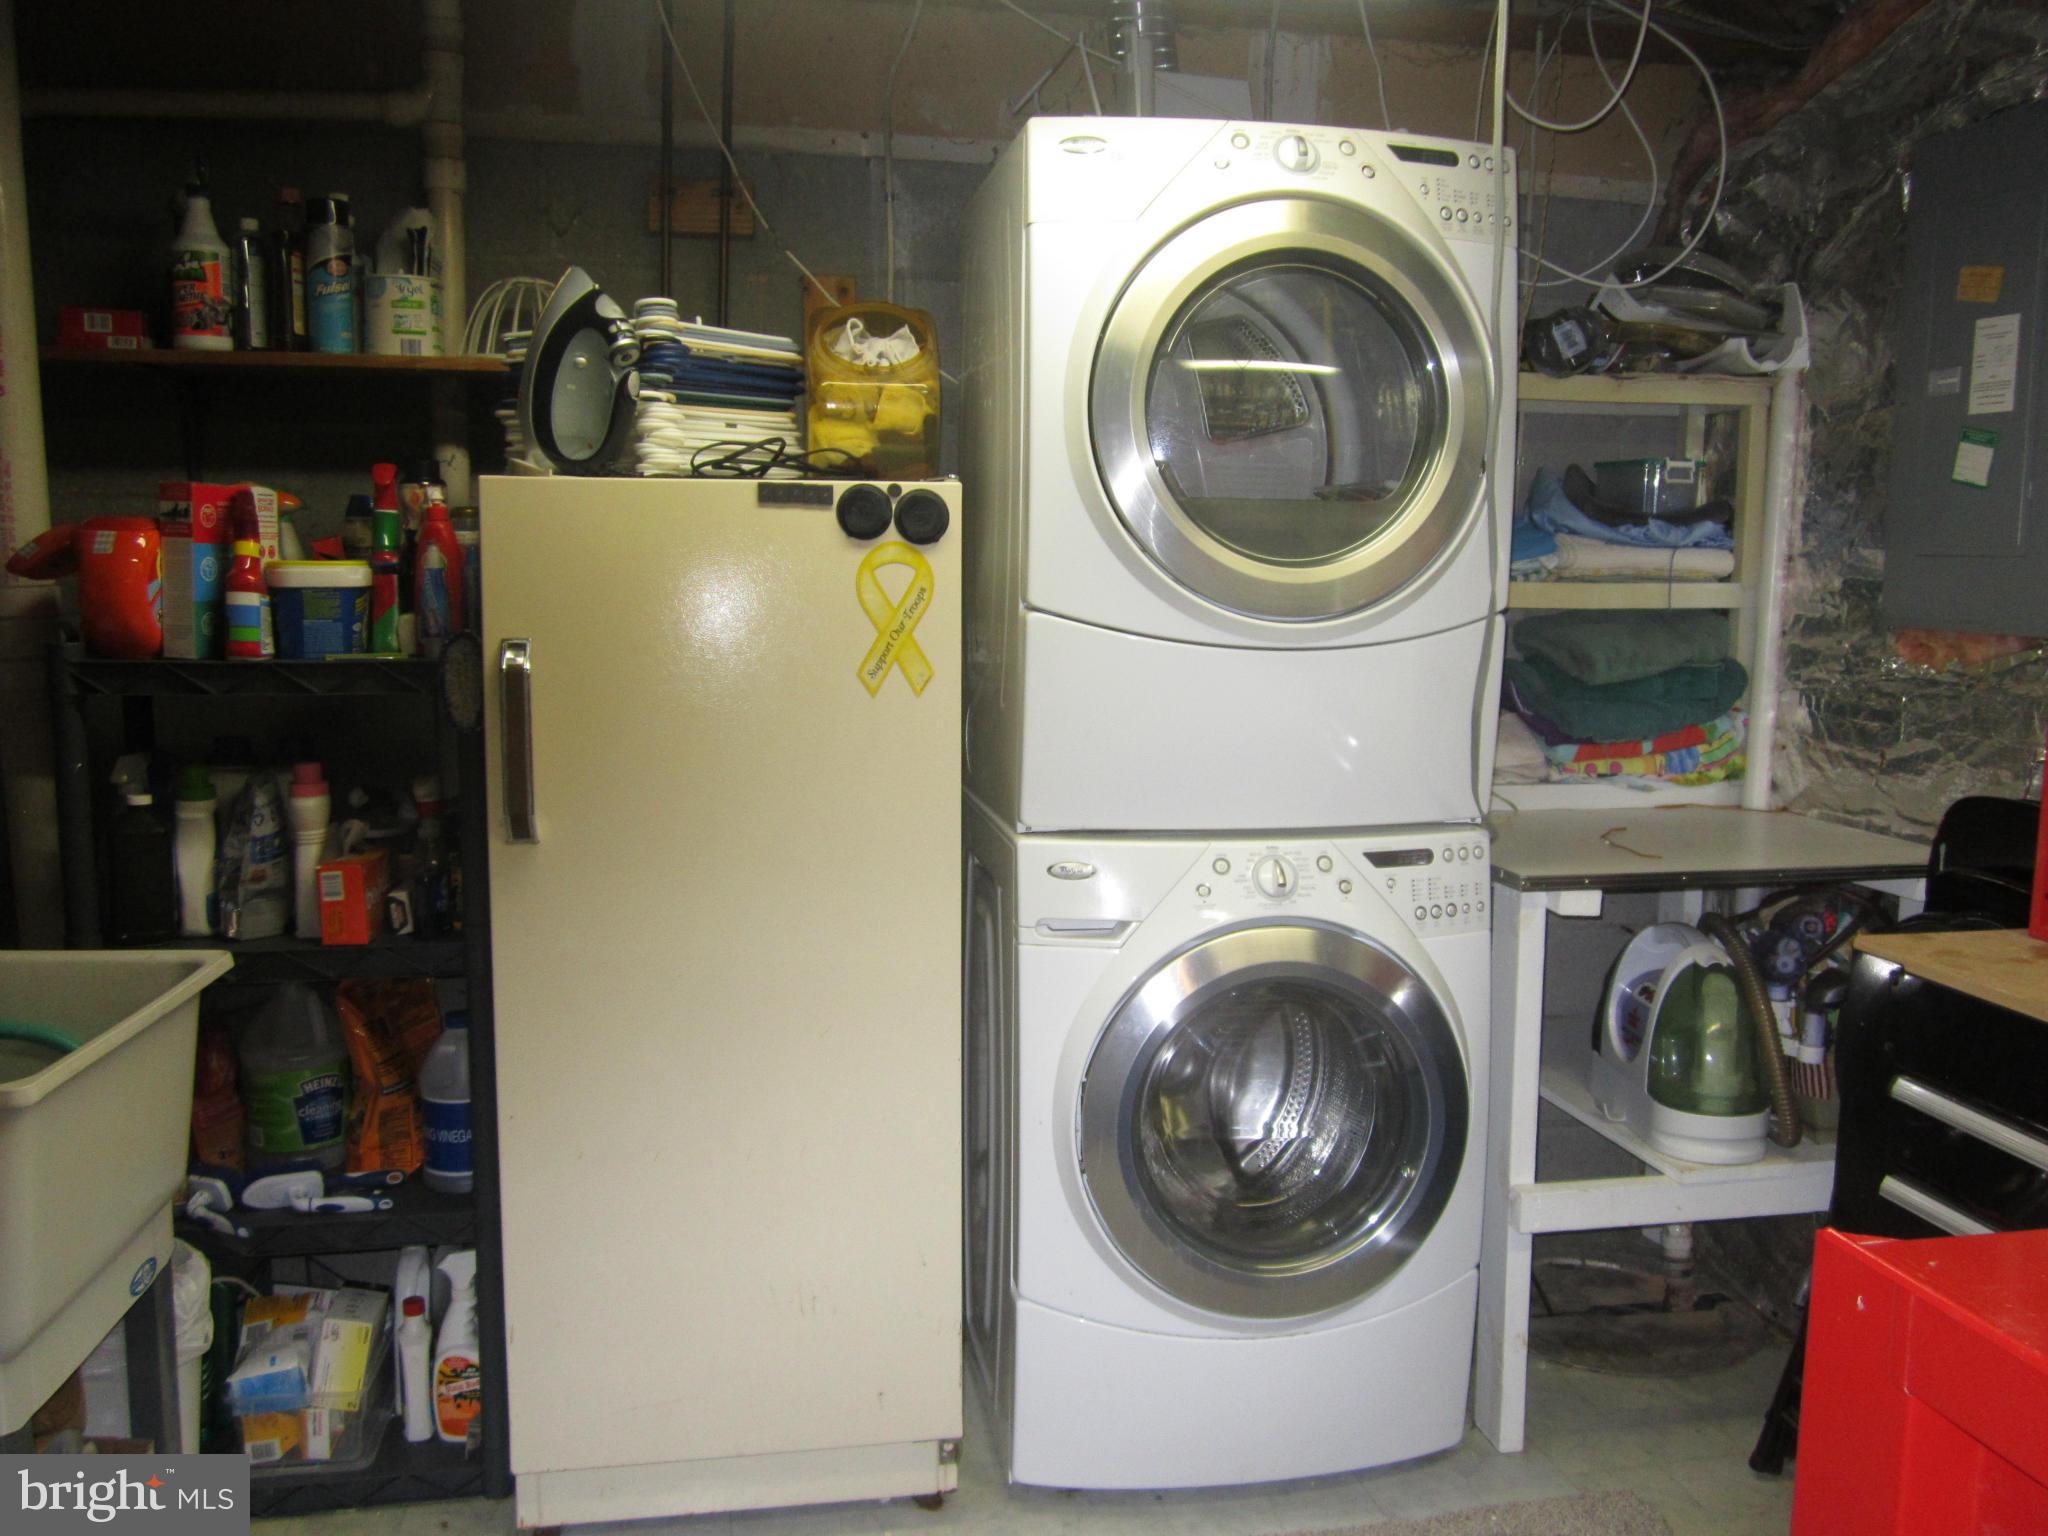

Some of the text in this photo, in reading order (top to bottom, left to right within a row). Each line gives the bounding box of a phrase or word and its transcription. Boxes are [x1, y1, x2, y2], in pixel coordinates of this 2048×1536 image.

[868, 587, 926, 679] Support Our Troops
[301, 1075, 338, 1093] HEINZ
[437, 1128, 472, 1143] VINEGA
